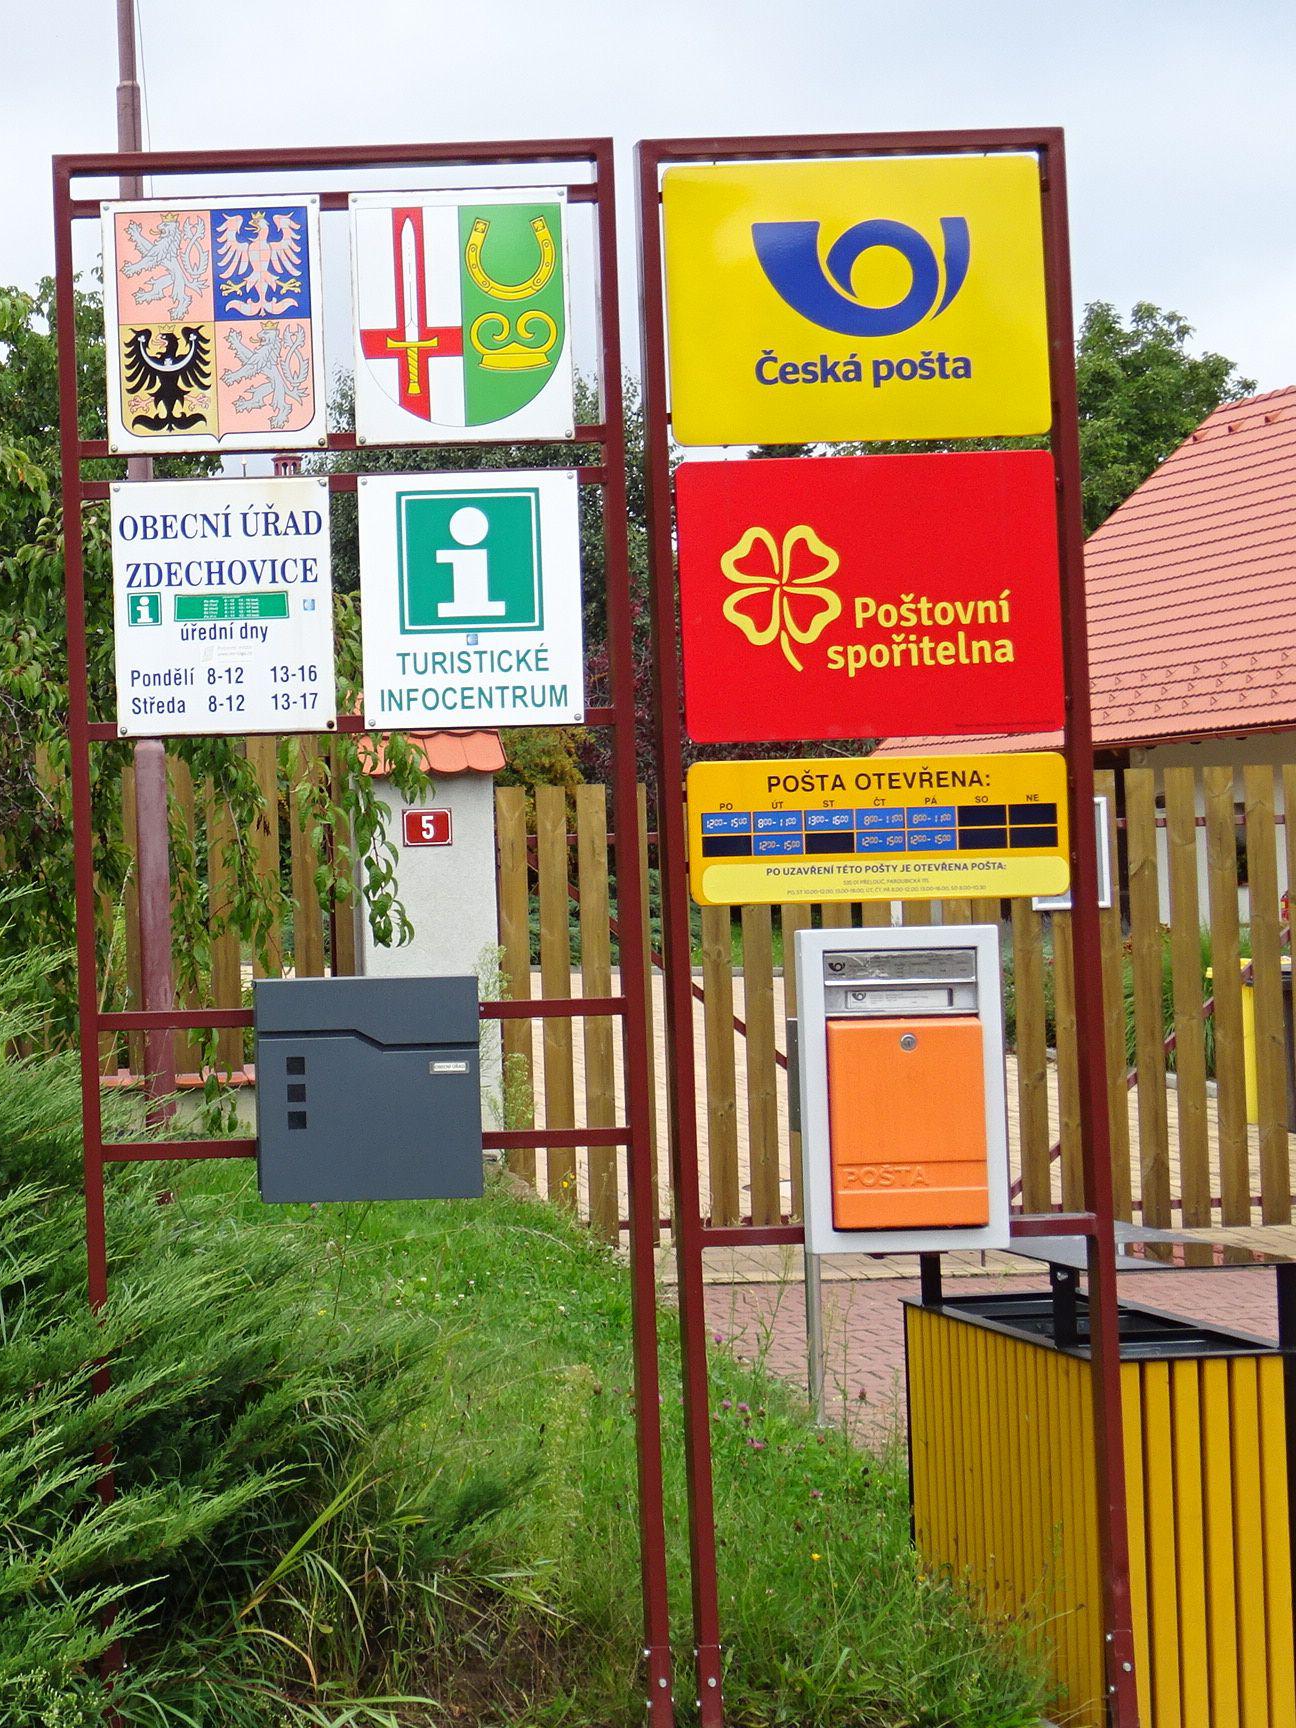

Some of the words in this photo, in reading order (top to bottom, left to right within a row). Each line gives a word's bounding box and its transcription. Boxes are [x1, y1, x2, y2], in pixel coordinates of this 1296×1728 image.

[755, 350, 862, 386] Česká
[873, 349, 972, 388] pošta
[119, 505, 231, 541] OBECNÍ
[240, 503, 322, 537] ÚŘAD
[126, 558, 318, 588] ZDECHOVICE
[855, 590, 1011, 629] Poštovní
[180, 622, 234, 641] úřední
[240, 623, 268, 642] dny
[397, 643, 550, 676] TURISTICKÉ
[827, 631, 1015, 678] spořitelna
[130, 666, 195, 688] Pondělí
[207, 666, 244, 685] 8-12
[270, 664, 318, 683] 13-16
[132, 696, 186, 715] Středa
[208, 694, 246, 712] 8-12
[272, 692, 319, 710] 13-17
[380, 684, 569, 713] INFOCENTRUM
[767, 769, 848, 793] POŠTA
[854, 766, 991, 792] OTEVŘENA:
[772, 801, 783, 809] ÚT
[874, 797, 886, 806] ČT
[924, 796, 937, 804] PÁ
[421, 816, 434, 840] 5
[766, 868, 780, 876] PO
[782, 865, 834, 876] UZAVŘENÍ
[836, 865, 862, 874] TÉTO
[864, 863, 898, 874] POŠTY
[900, 864, 911, 873] JE
[913, 862, 969, 872] OTEVŘENA
[971, 861, 1007, 871] POŠTA:
[842, 1164, 929, 1188] POŠTA
